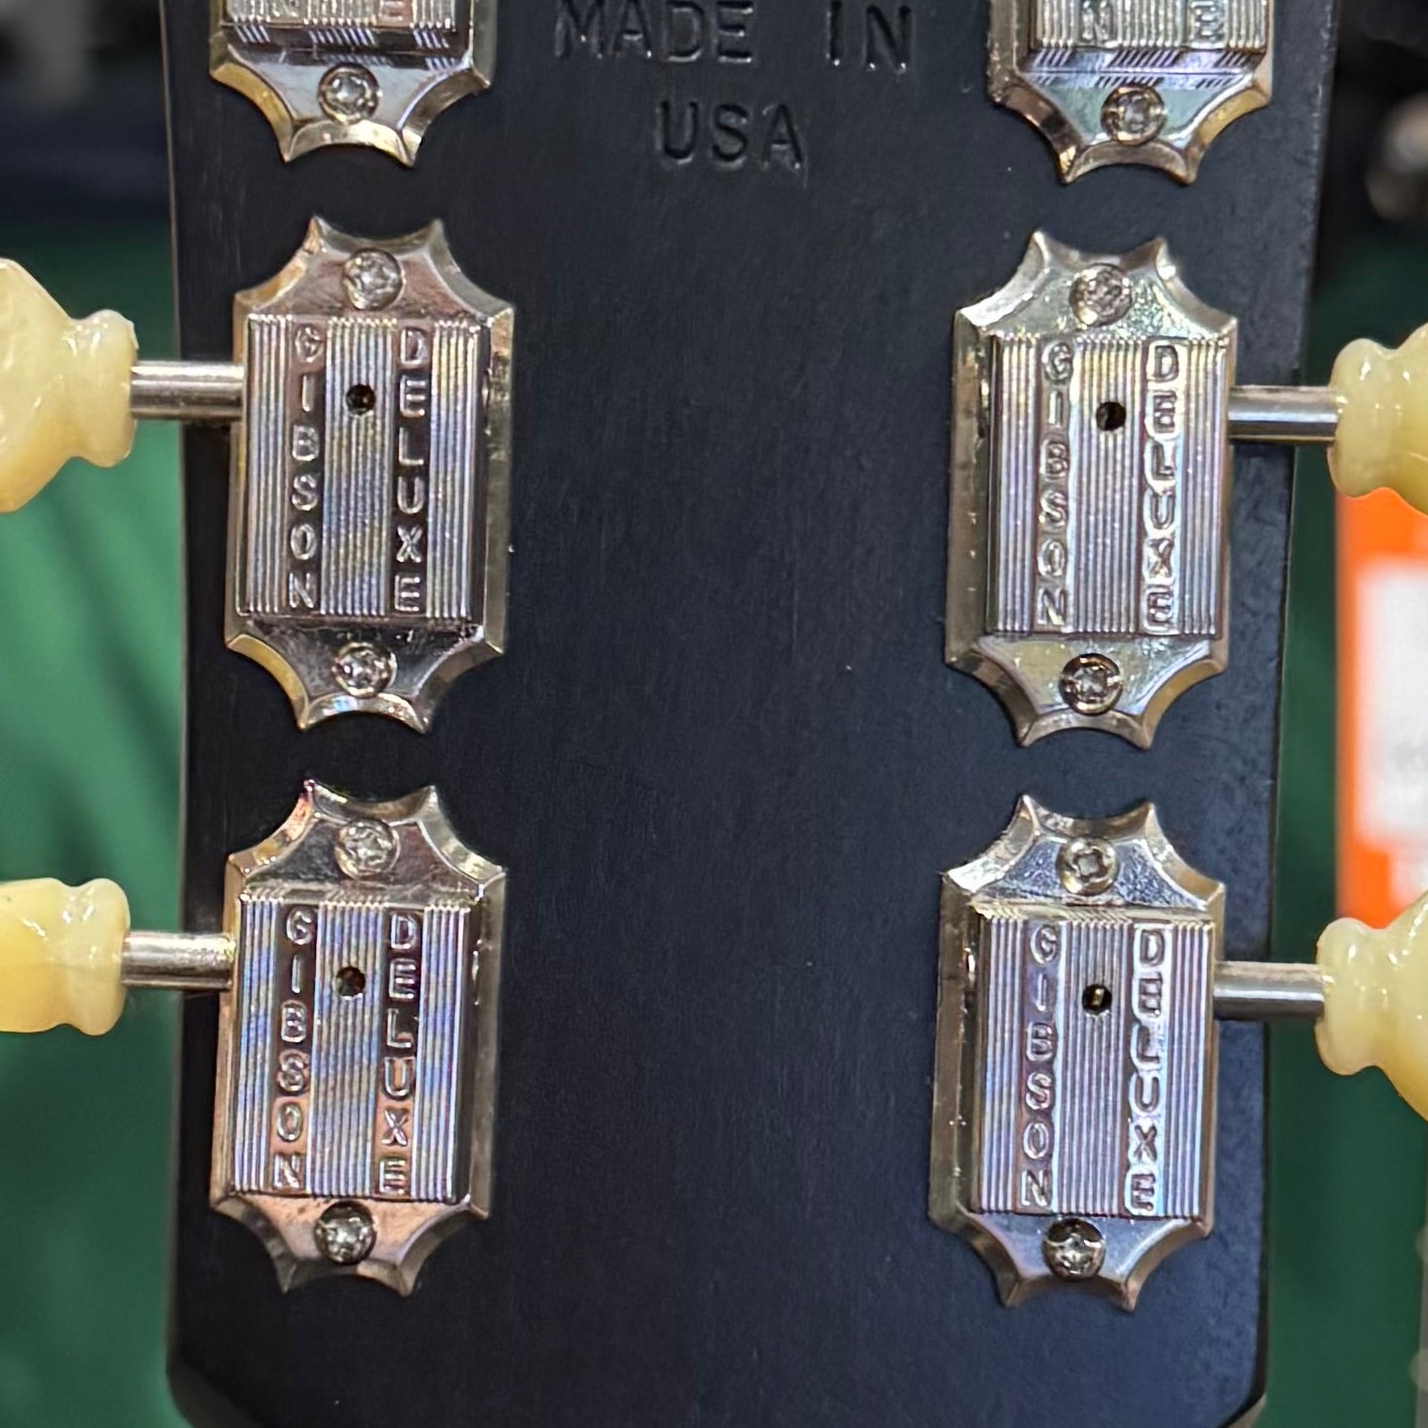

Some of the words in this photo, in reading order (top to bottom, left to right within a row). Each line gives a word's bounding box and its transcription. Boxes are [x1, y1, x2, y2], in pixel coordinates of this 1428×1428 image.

[655, 100, 806, 170] USA
[288, 326, 323, 609] GIBSON
[394, 327, 429, 613] DELUXE
[1037, 341, 1072, 628] GIBSON
[1143, 342, 1182, 627] DELUXE
[274, 909, 314, 1191] GIBSON
[378, 913, 418, 1195] DELUXE
[1021, 924, 1061, 1208] GIBSON
[1127, 929, 1166, 1212] DELUXE
